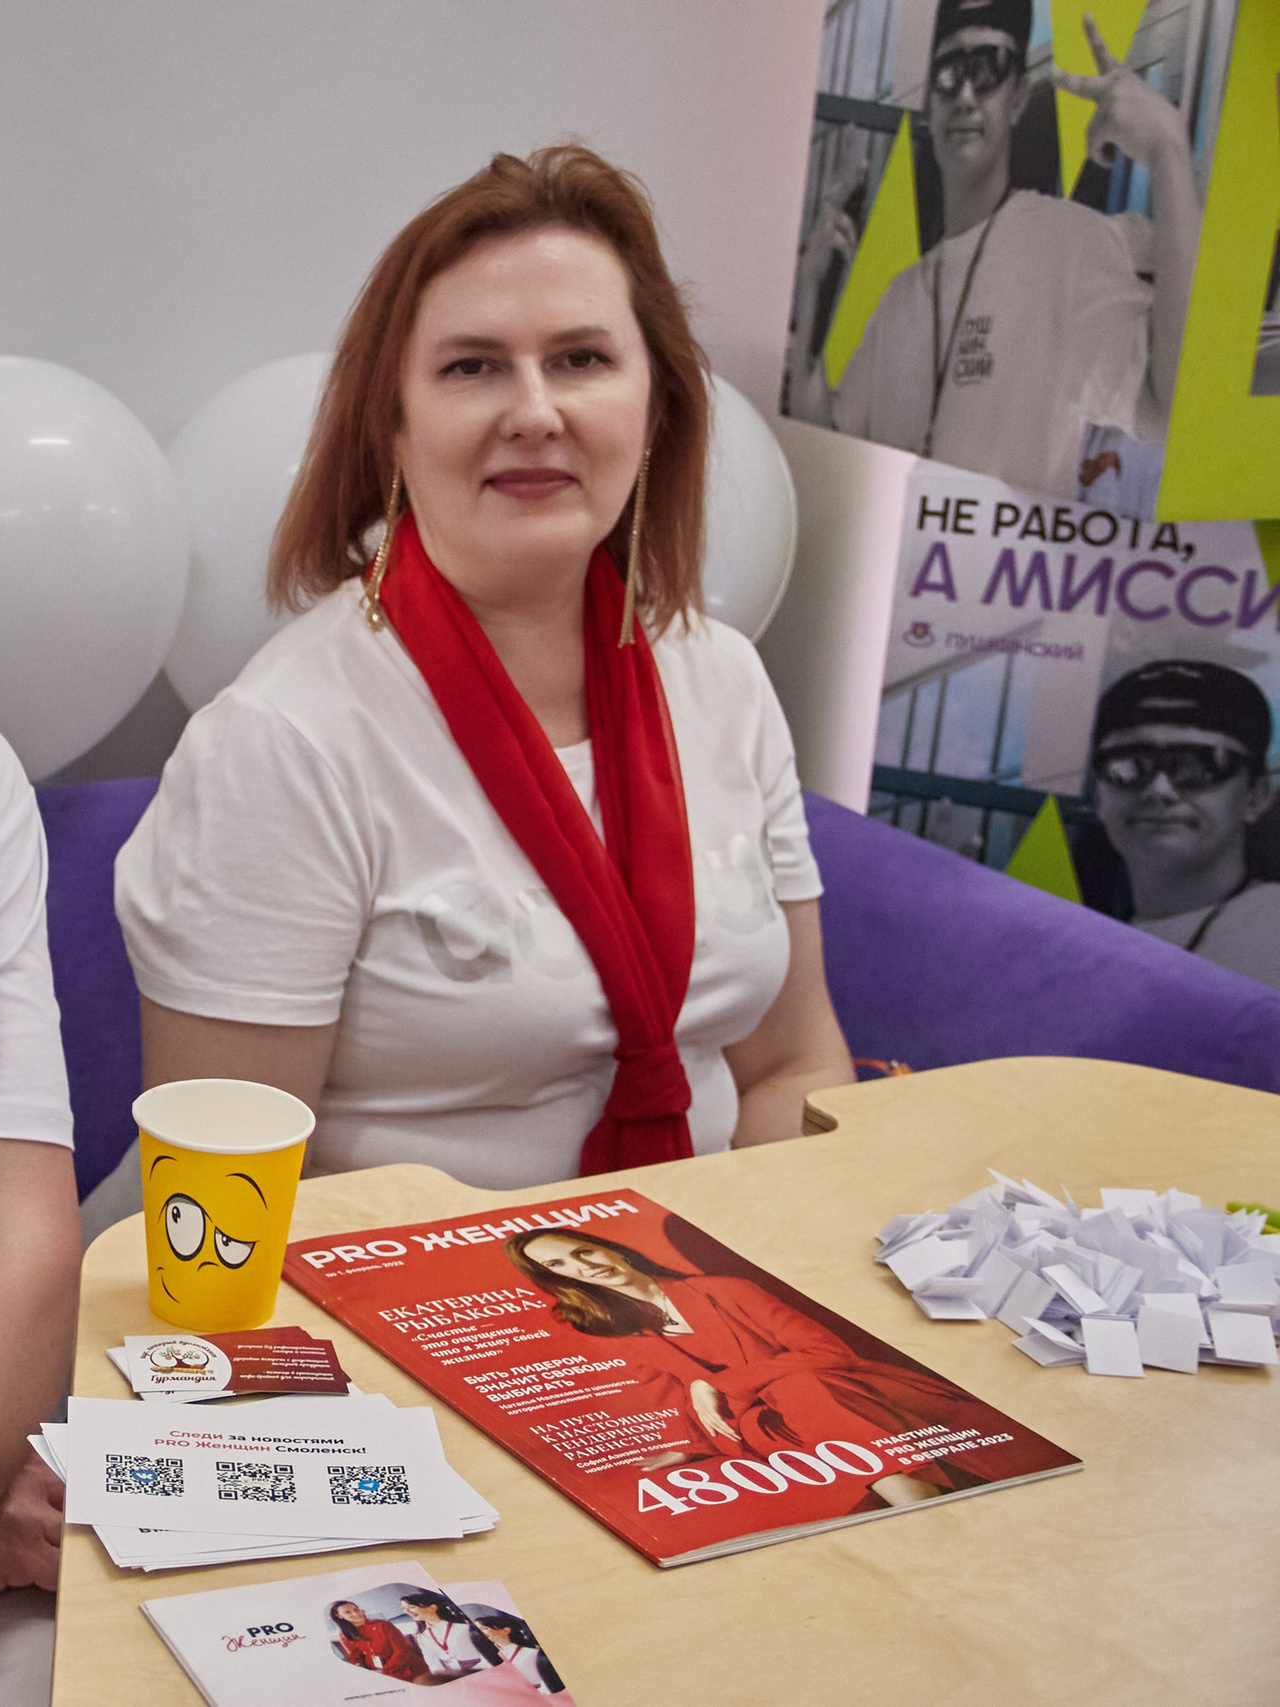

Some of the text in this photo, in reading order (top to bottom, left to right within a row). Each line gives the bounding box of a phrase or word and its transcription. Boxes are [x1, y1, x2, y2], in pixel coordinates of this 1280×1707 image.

[917, 495, 979, 535] НЕ
[909, 541, 958, 602] А
[300, 1199, 639, 1268] PRO ЖЕНЩИН
[377, 1287, 536, 1322] ЕКАТЕРИНА
[392, 1299, 548, 1334] РЫБАКОВА:
[411, 1324, 478, 1343] «Счастье
[420, 1325, 525, 1351] это ощущение,
[430, 1329, 551, 1359] что я живу своей
[441, 1349, 504, 1367] жизнью»
[463, 1355, 588, 1385] БЫТЬ ЛИДЕРОМ
[151, 1375, 216, 1384] Гурмандия
[475, 1358, 627, 1394] ЗНАЧИТ СВОБОДНО
[486, 1379, 575, 1403] ВЫБИРАТЬ
[170, 1430, 223, 1440] Следи
[251, 1436, 345, 1444] новостями
[529, 1411, 611, 1435] НА ПУТИ
[540, 1408, 680, 1444] К НАСТОЯЩЕМУ
[552, 1420, 667, 1452] ГЕНДЕРНОМУ
[870, 1424, 949, 1449] УЧАСТНИЦ
[154, 1438, 367, 1454] PRO Женщин Смоленск!
[563, 1432, 663, 1461] РАВЕНСТВУ
[883, 1428, 981, 1457] PRO ЖЕНЩИН
[897, 1433, 1015, 1466] В ФЕВРАЛЕ 2023
[584, 1463, 614, 1474] новой
[222, 1633, 307, 1652] Женщин
[246, 1622, 294, 1638] PRO
